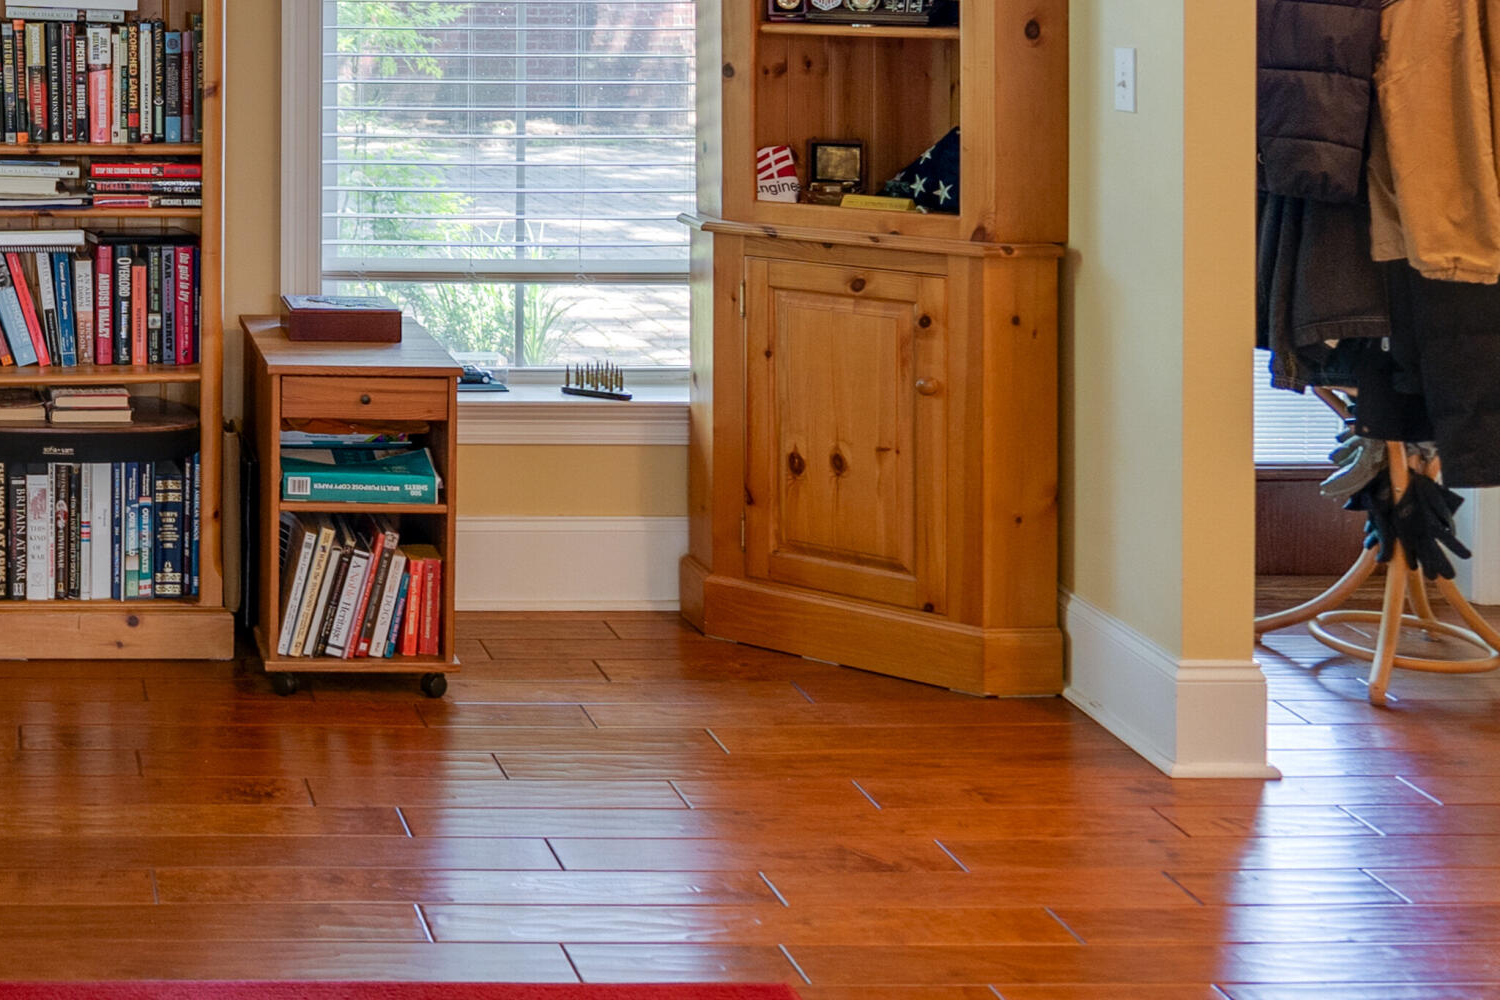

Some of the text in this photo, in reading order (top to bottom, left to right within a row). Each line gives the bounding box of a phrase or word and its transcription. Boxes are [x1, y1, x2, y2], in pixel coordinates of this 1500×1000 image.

[3, 39, 13, 93] FUTURE JIHAD
[128, 26, 138, 109] SCORCHED EARTH
[155, 62, 163, 77] ANY
[76, 40, 85, 120] EPICENTER ROSENBERG
[155, 77, 163, 98] PLACE
[33, 73, 43, 125] TWELFTH IMAM
[179, 252, 190, 265] the
[117, 257, 132, 297] OVERLORD
[178, 265, 189, 281] guts
[77, 284, 86, 307] DAWN
[84, 284, 92, 307] ARMY
[98, 273, 110, 339] AMBUSH VALLEY
[121, 301, 129, 313] Max
[178, 290, 190, 303] try
[164, 312, 173, 351] MERCY
[313, 482, 333, 490] PAPER
[351, 483, 380, 491] PURPOSE
[380, 484, 400, 492] MULTI
[404, 484, 429, 492] SHEETS
[16, 488, 26, 581] BRITAIN AT WAR
[331, 561, 362, 643] A Noble Heritage
[380, 594, 393, 627] DOGS
